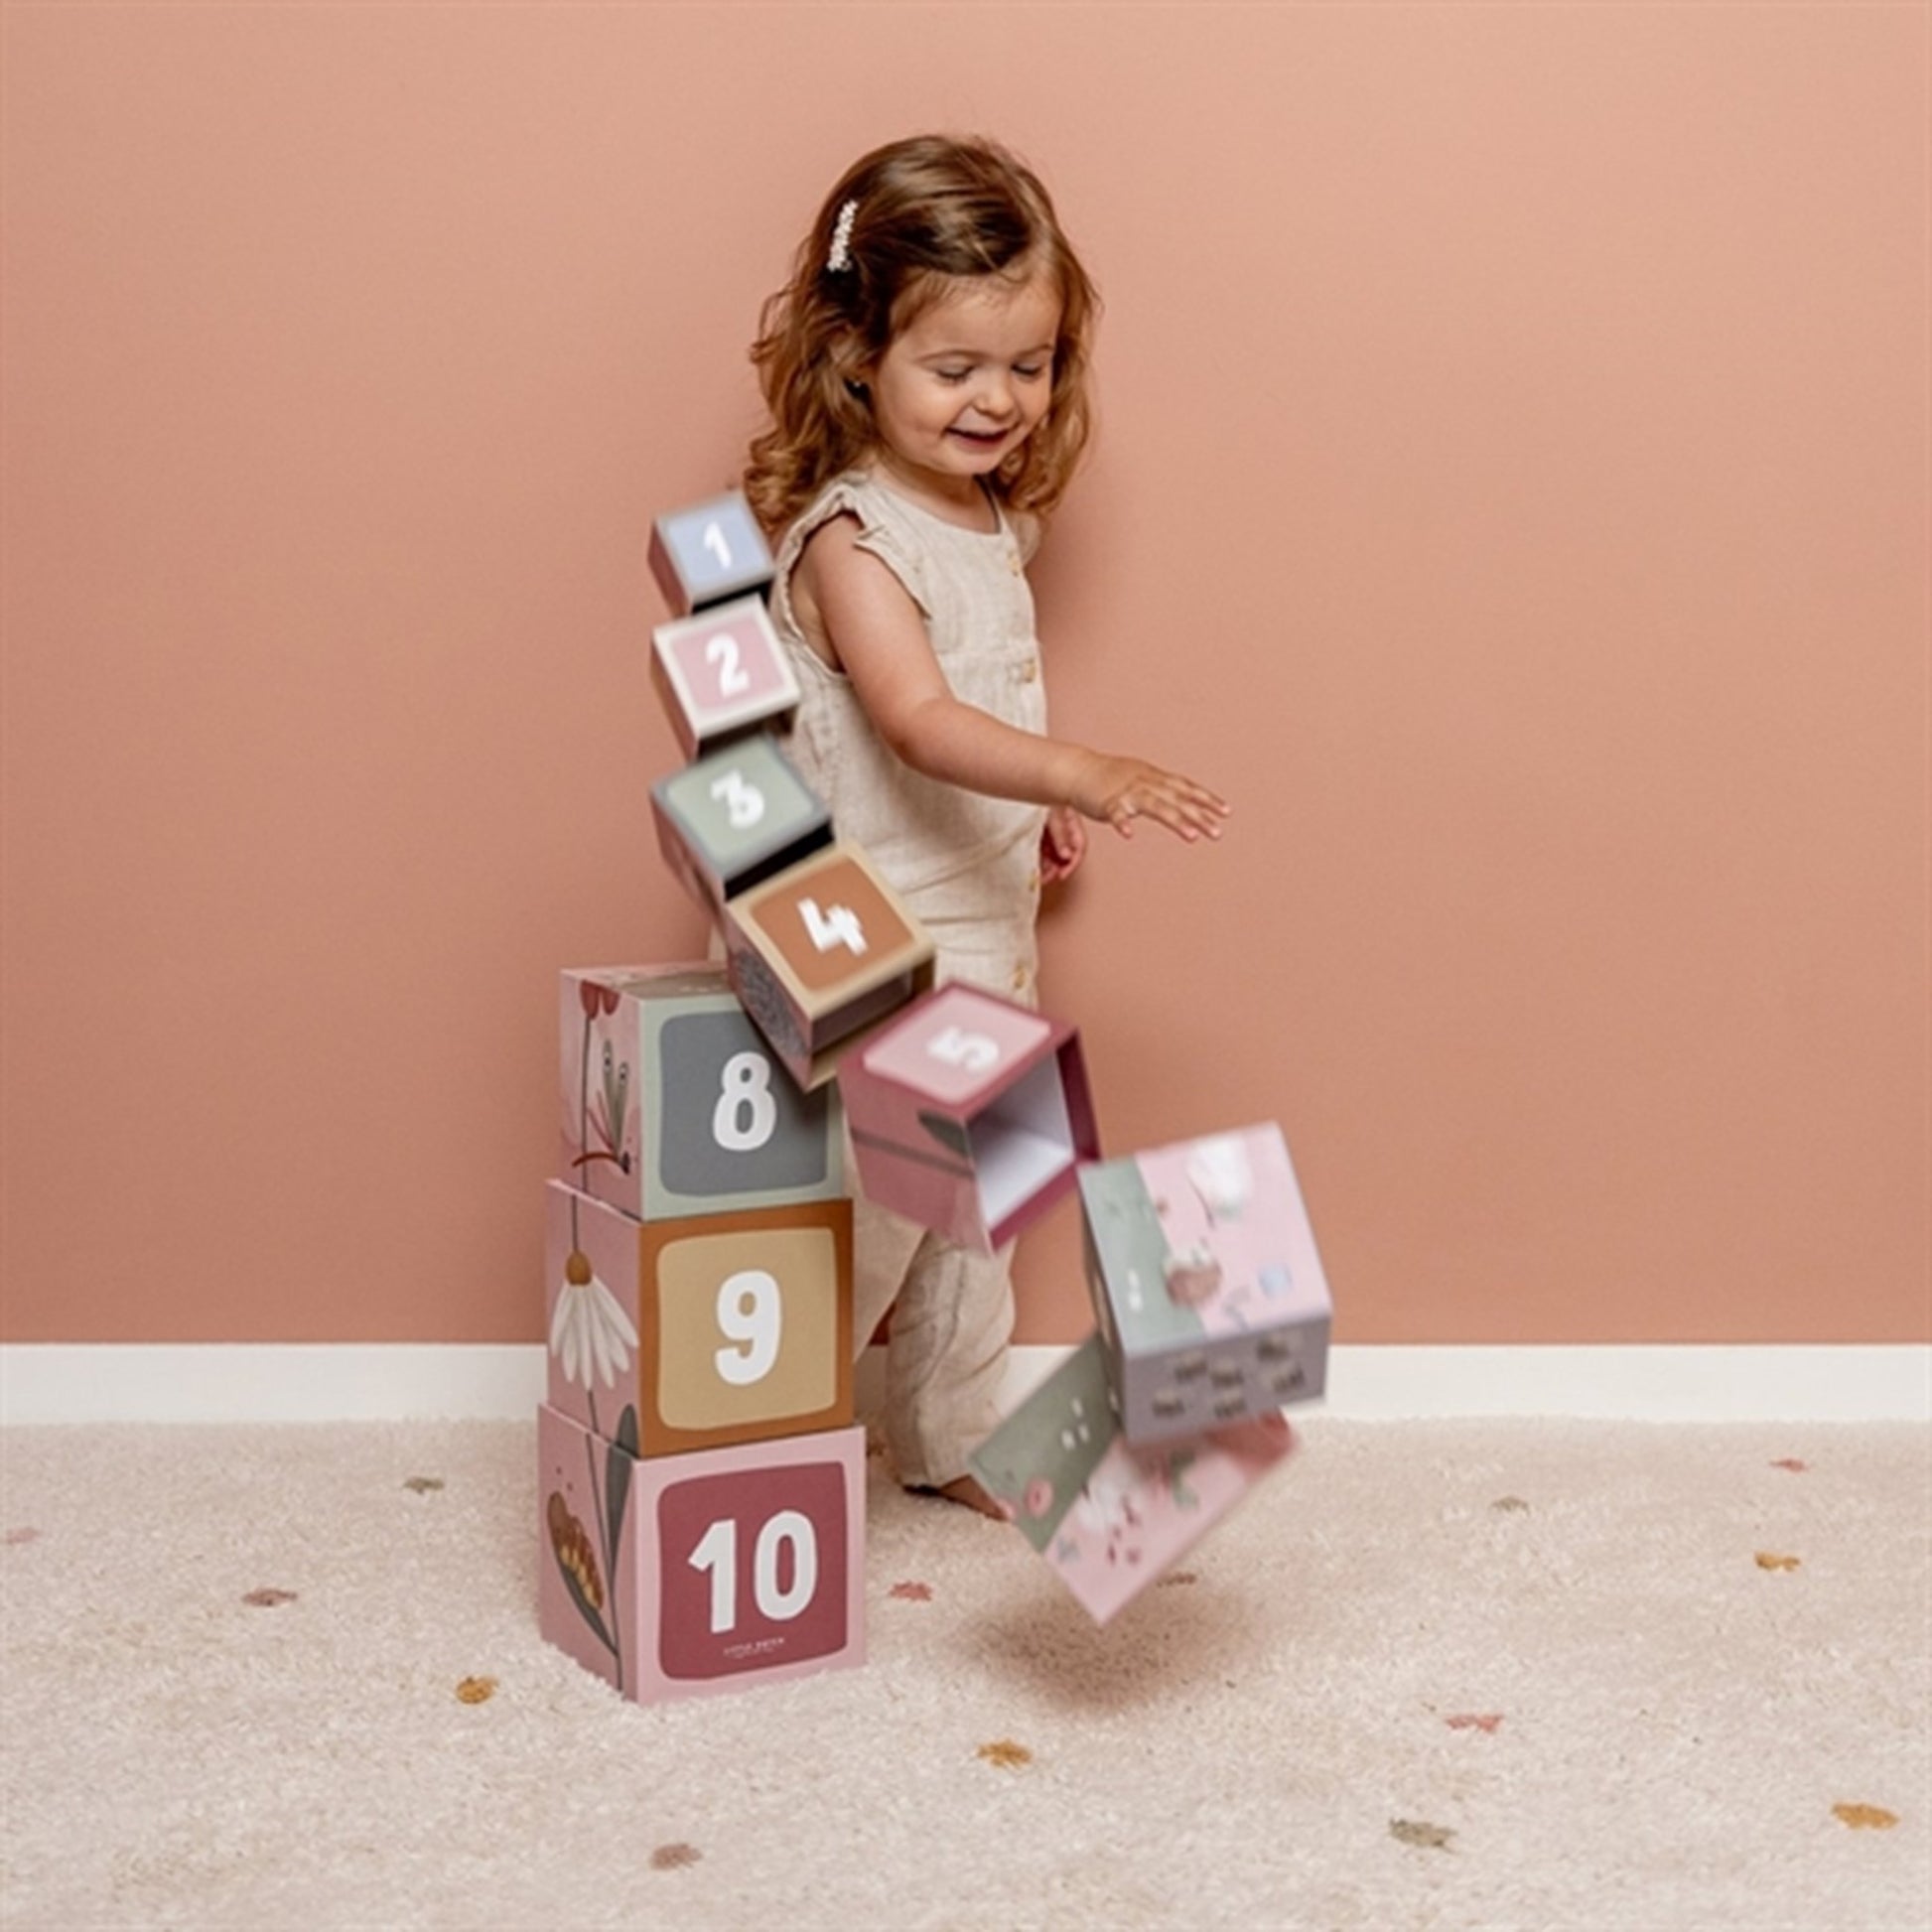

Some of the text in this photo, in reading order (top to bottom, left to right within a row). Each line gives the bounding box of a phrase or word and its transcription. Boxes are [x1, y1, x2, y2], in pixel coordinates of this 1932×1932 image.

[704, 522, 731, 568] 1
[706, 635, 749, 696] 2
[712, 772, 764, 828] 3
[799, 899, 866, 953] 4
[928, 1028, 999, 1070] 5
[713, 1052, 775, 1151] 8
[714, 1271, 781, 1384] 9
[689, 1511, 816, 1632] 10
